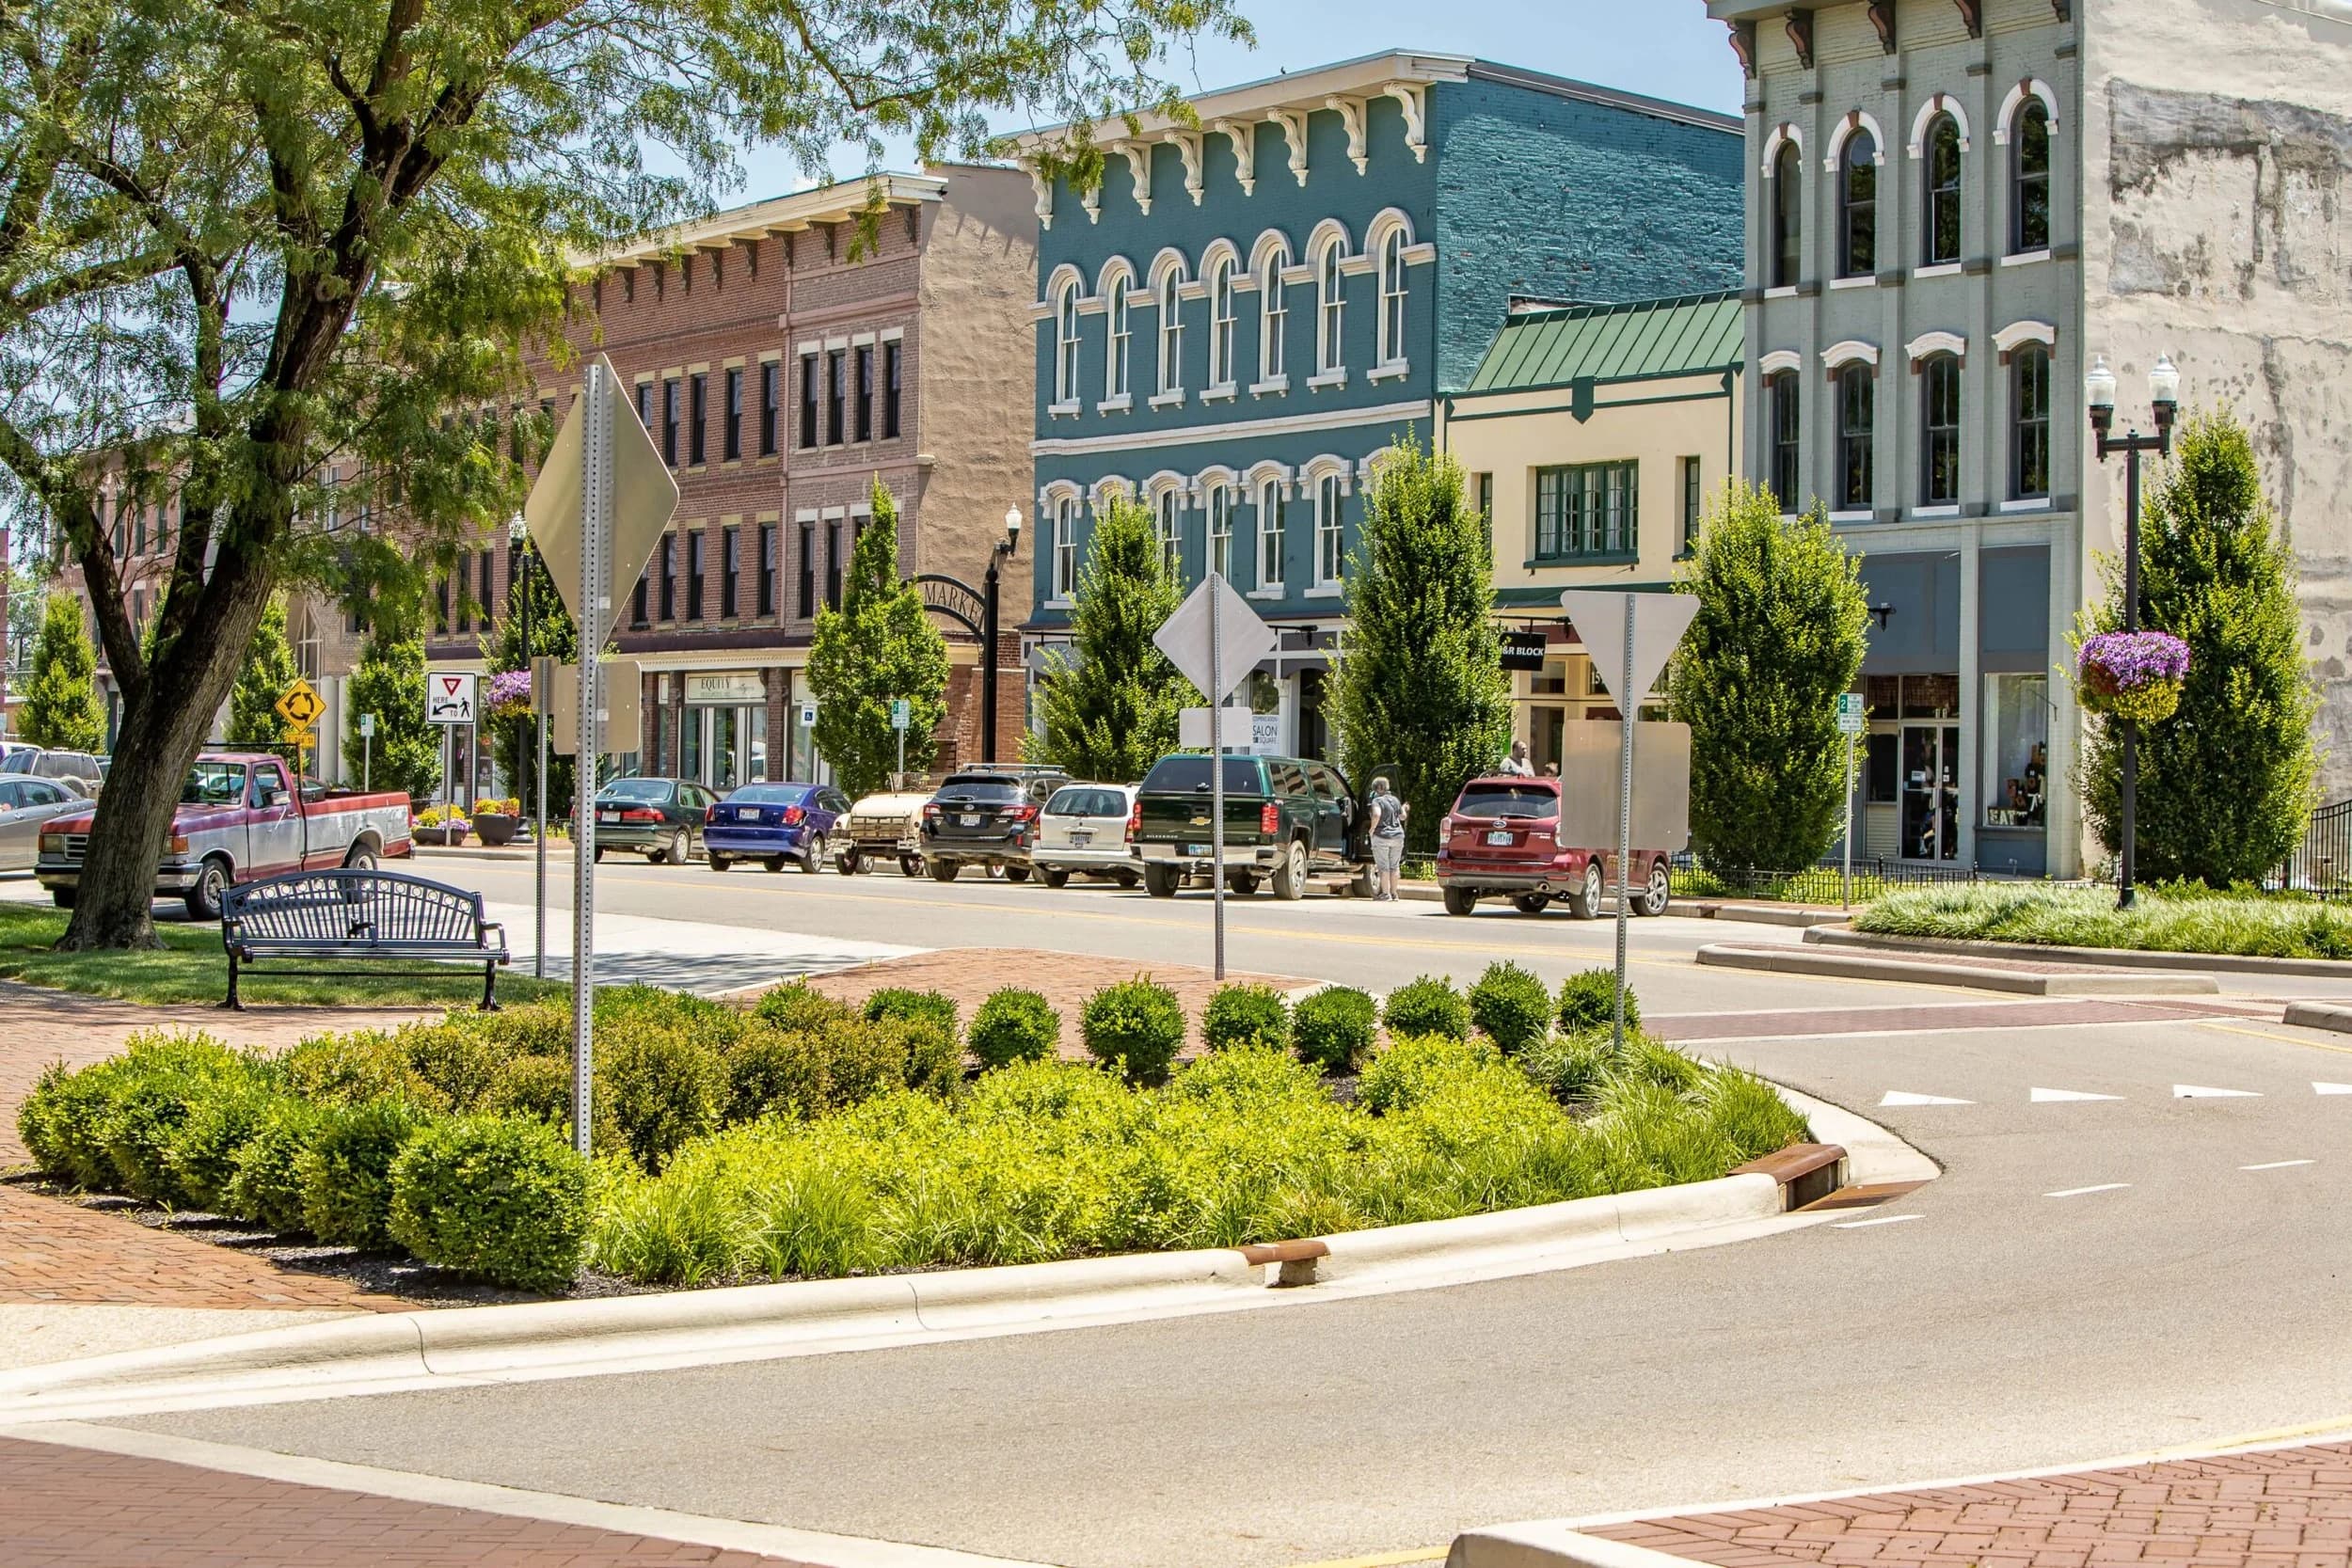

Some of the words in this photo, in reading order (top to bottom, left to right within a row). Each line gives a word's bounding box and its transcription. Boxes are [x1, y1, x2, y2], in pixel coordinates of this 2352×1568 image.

[1502, 646, 1515, 656] &R
[1517, 646, 1544, 656] BLOCK
[701, 677, 730, 690] EQUITY
[1840, 699, 1847, 709] 2
[1252, 725, 1278, 736] SALON
[1989, 810, 2015, 826] EAT
